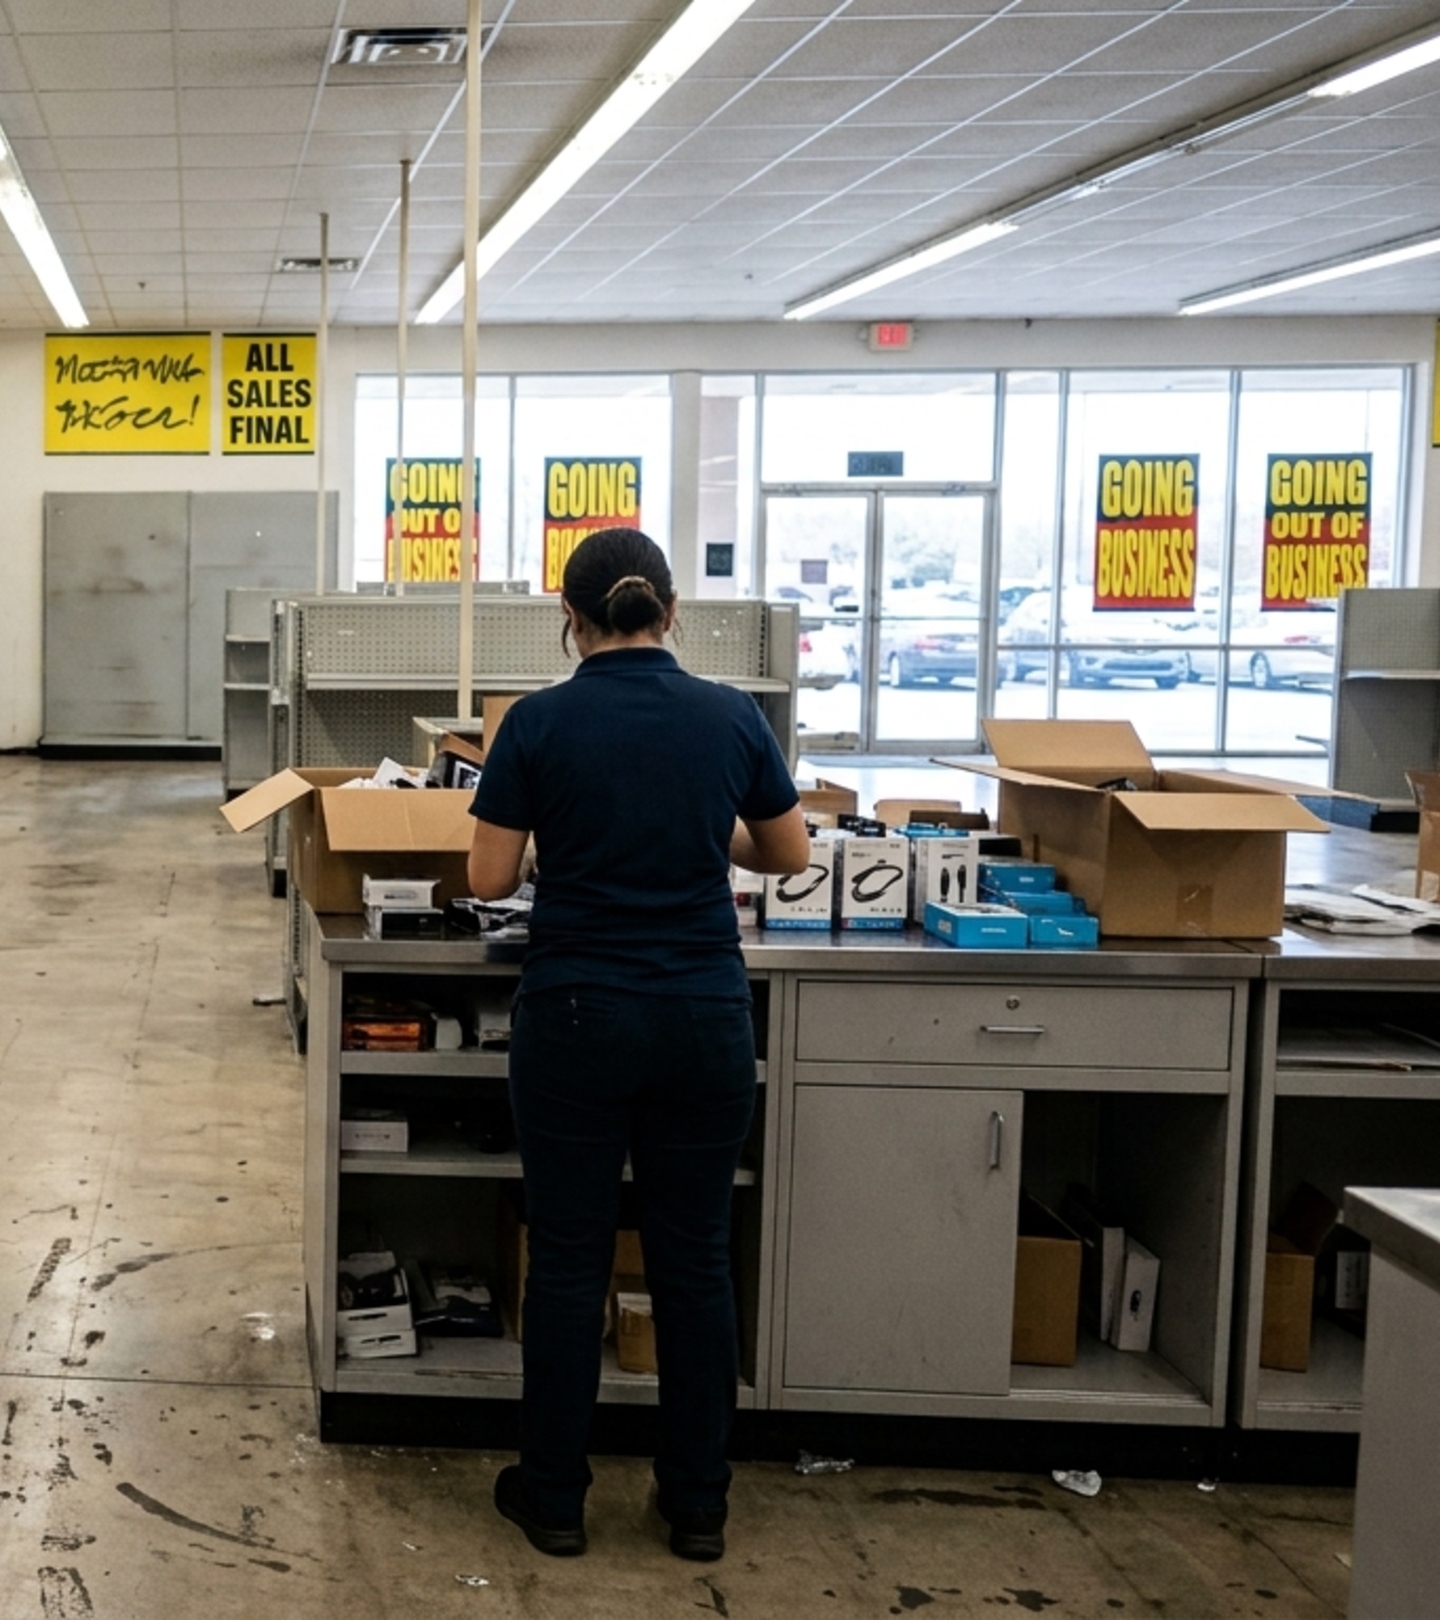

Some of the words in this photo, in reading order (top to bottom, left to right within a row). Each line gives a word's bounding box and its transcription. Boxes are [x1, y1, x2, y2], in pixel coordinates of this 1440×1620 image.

[245, 343, 294, 373] ALL
[227, 378, 312, 409] SALES
[229, 415, 310, 445] FINAL
[548, 461, 637, 518] GOING
[1101, 458, 1195, 518] GOING
[1270, 458, 1368, 507] GOING
[1271, 511, 1326, 540] OUT
[1330, 511, 1366, 540] OF
[1097, 527, 1195, 599] BUSINESS
[1264, 543, 1368, 600] BUSINESS
